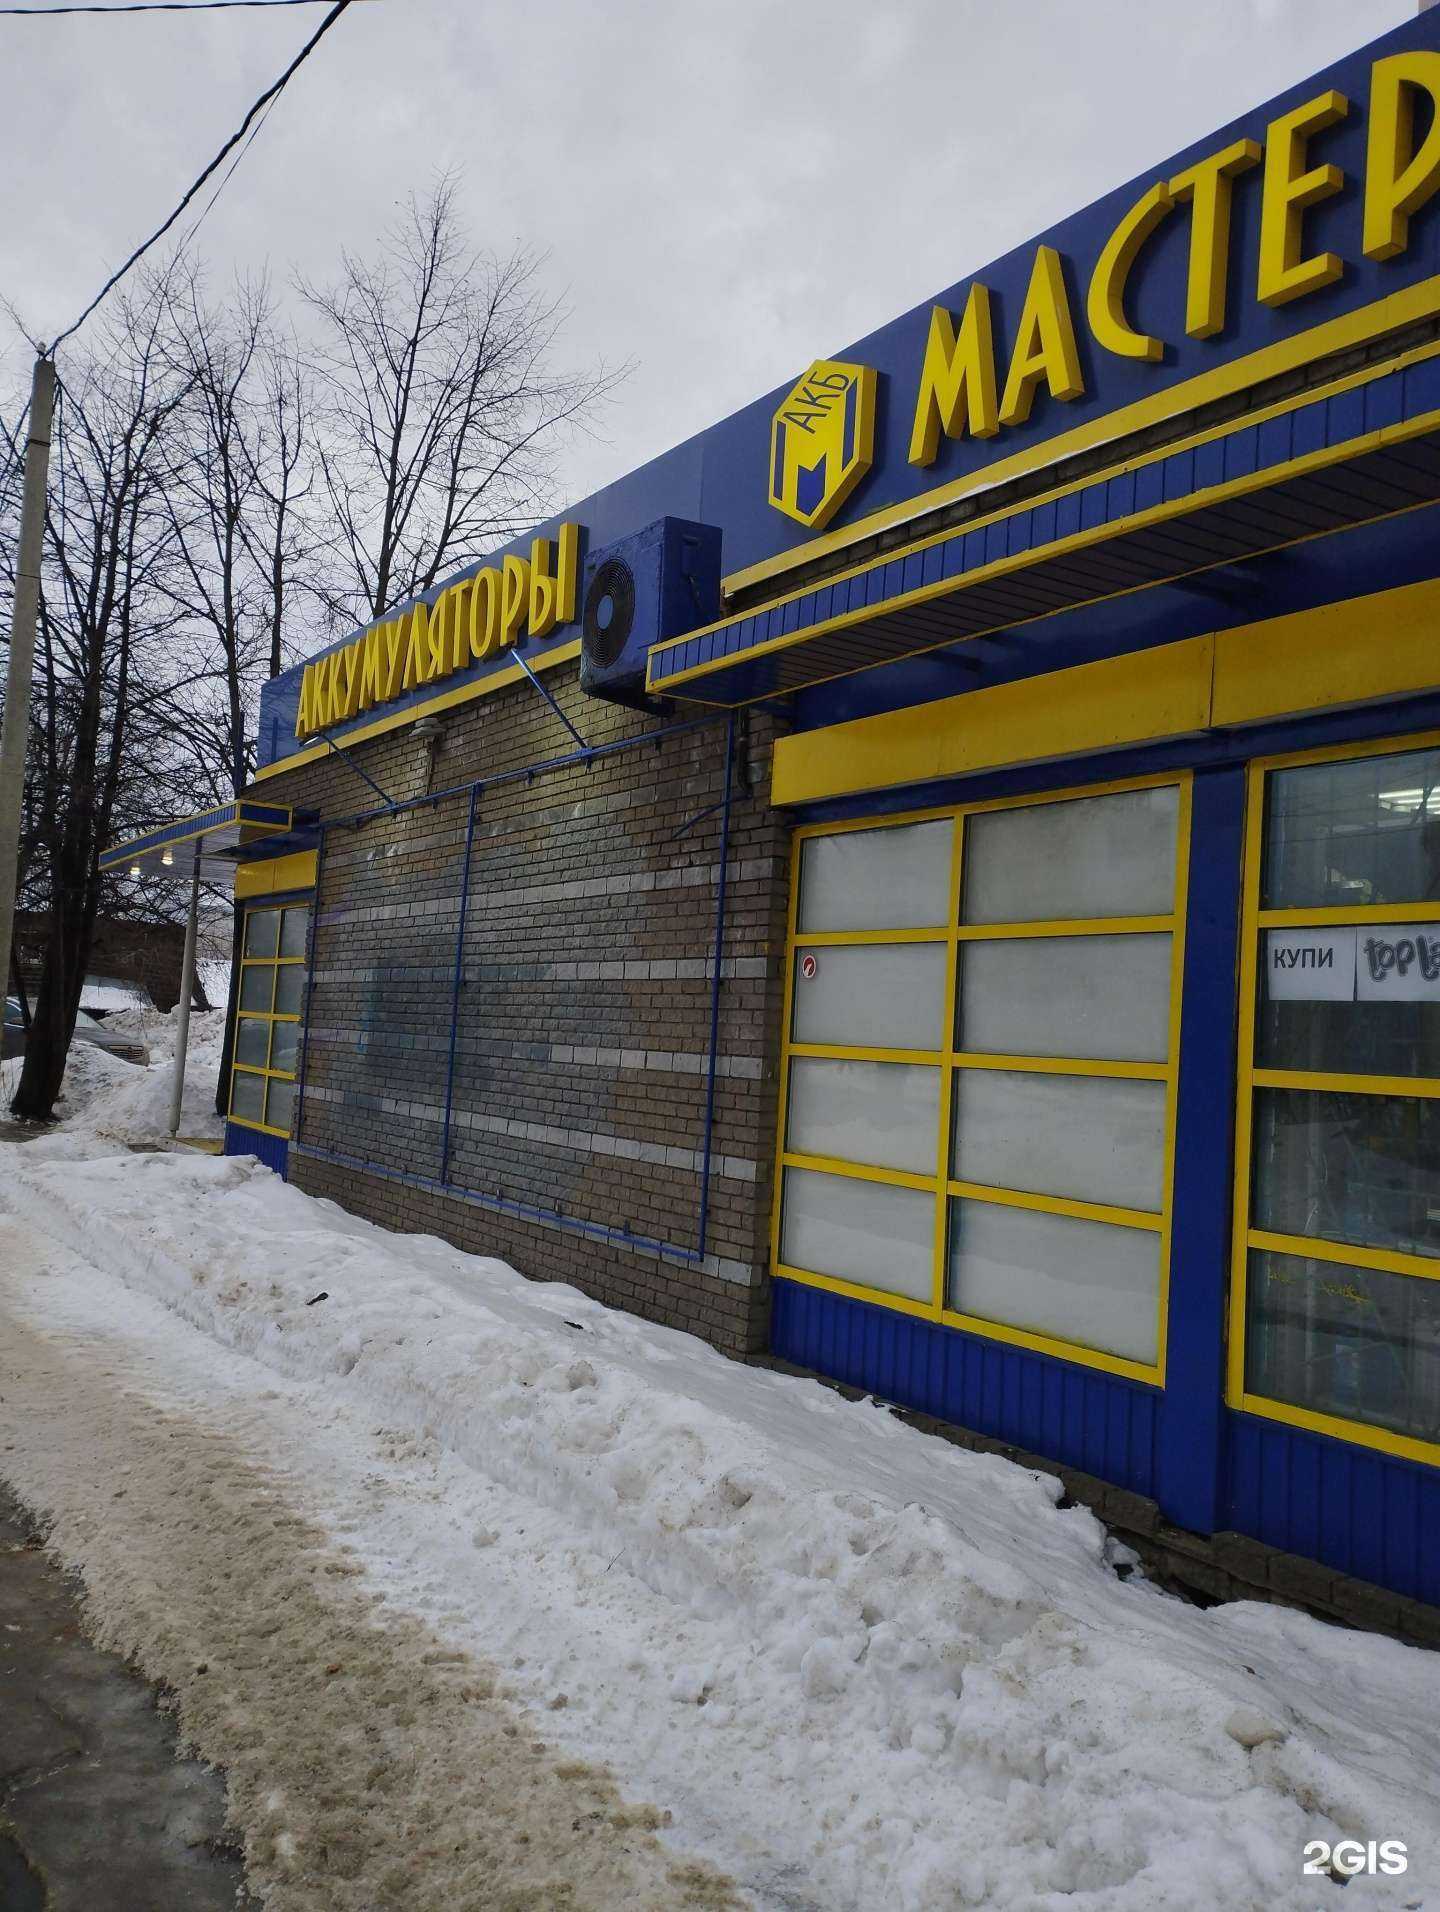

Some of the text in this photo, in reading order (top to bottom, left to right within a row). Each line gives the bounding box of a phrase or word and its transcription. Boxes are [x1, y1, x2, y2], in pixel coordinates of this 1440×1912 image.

[908, 51, 1440, 468] МАСТЕР
[783, 371, 849, 434] АКБ
[296, 523, 580, 736] АККУМУЛЯТОРЫ
[1273, 947, 1333, 969] КУПИ
